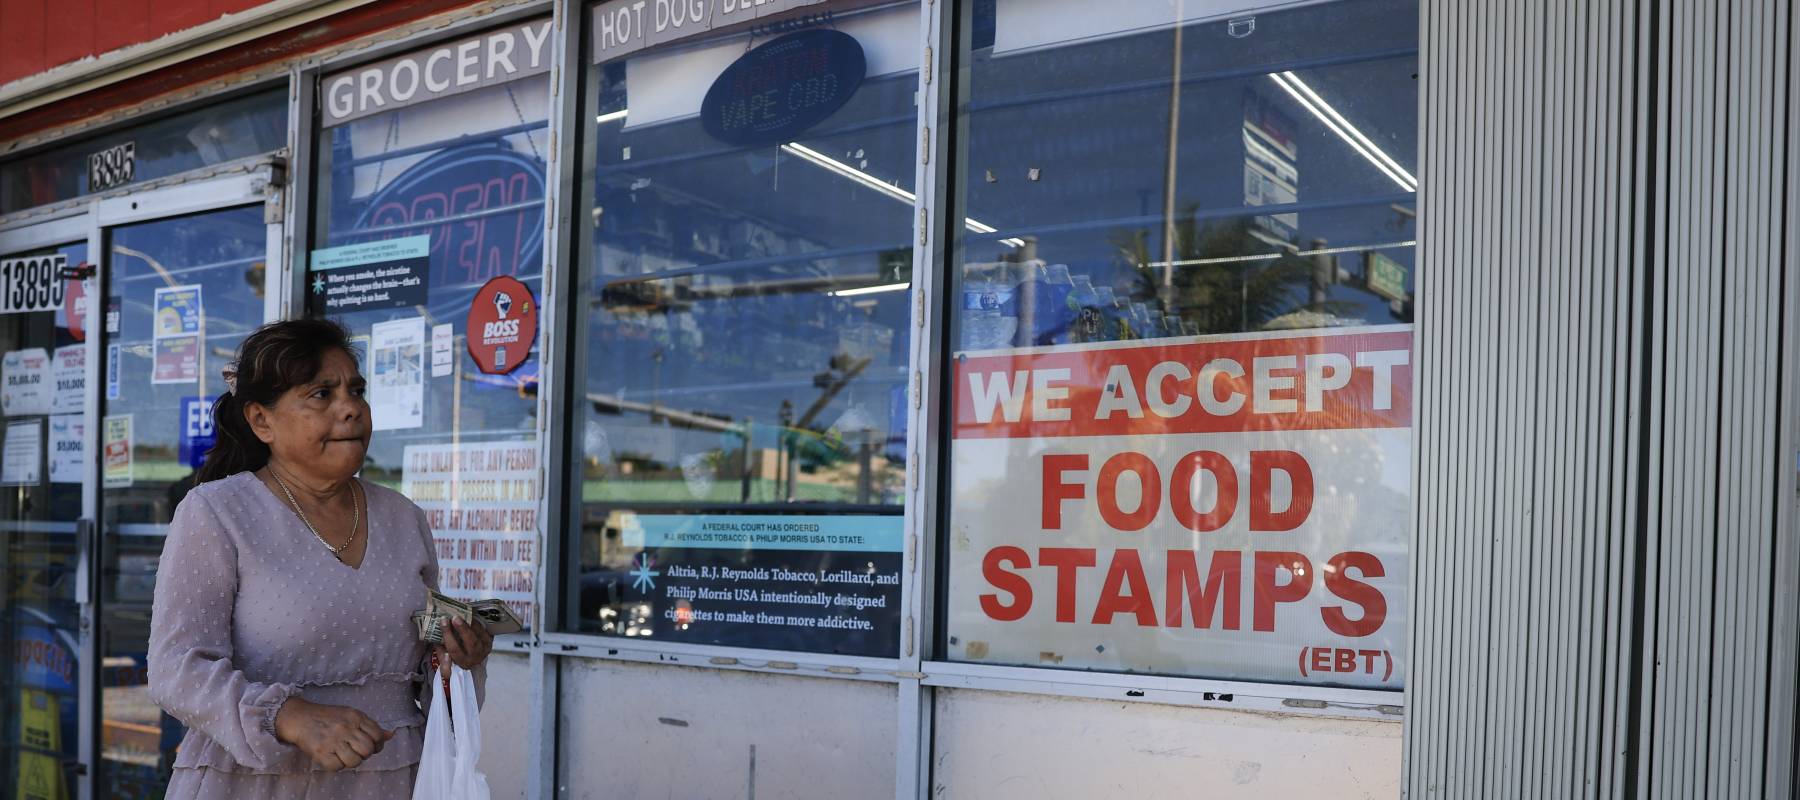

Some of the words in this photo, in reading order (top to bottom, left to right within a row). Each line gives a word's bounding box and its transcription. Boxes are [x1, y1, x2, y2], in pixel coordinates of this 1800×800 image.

[601, 1, 645, 50] HOT
[328, 21, 553, 120] GROCERY
[720, 88, 779, 131] VAPE
[787, 73, 838, 110] CBD
[88, 143, 134, 191] 13895
[3, 257, 66, 310] 13895
[483, 319, 520, 338] BOSS
[968, 367, 1072, 424] WE
[1094, 349, 1409, 420] ACCEPT
[1041, 450, 1315, 532] FOOD
[677, 533, 712, 541] REYNOLDS
[715, 533, 747, 542] TOBACCO
[756, 534, 778, 543] PHILIP
[780, 535, 808, 543] MORRIS
[810, 535, 825, 543] USA
[827, 535, 837, 544] TO
[839, 535, 864, 544] STATE:
[702, 523, 706, 531] A
[708, 523, 740, 531] FEDERAL
[741, 523, 764, 531] COURT
[767, 523, 782, 532] HAS
[784, 523, 820, 532] ORDERED
[666, 586, 696, 602] Philip
[698, 587, 732, 600] Morris
[734, 588, 758, 602] USA
[760, 589, 832, 608] intentionally
[834, 593, 886, 610] designed
[667, 565, 699, 580] Altria,
[701, 566, 719, 580] R.J.
[721, 567, 769, 581] Reynolds
[771, 568, 818, 584] Tobacco,
[821, 569, 874, 586] Lorillard,
[876, 572, 899, 585] and
[979, 545, 1387, 637] STAMPS
[664, 606, 713, 623] cigarettes
[714, 610, 724, 621] to
[726, 610, 754, 623] make
[756, 611, 784, 625] them
[787, 616, 815, 627] more
[817, 615, 874, 630] addictive.
[1298, 646, 1393, 682] (EBT)
